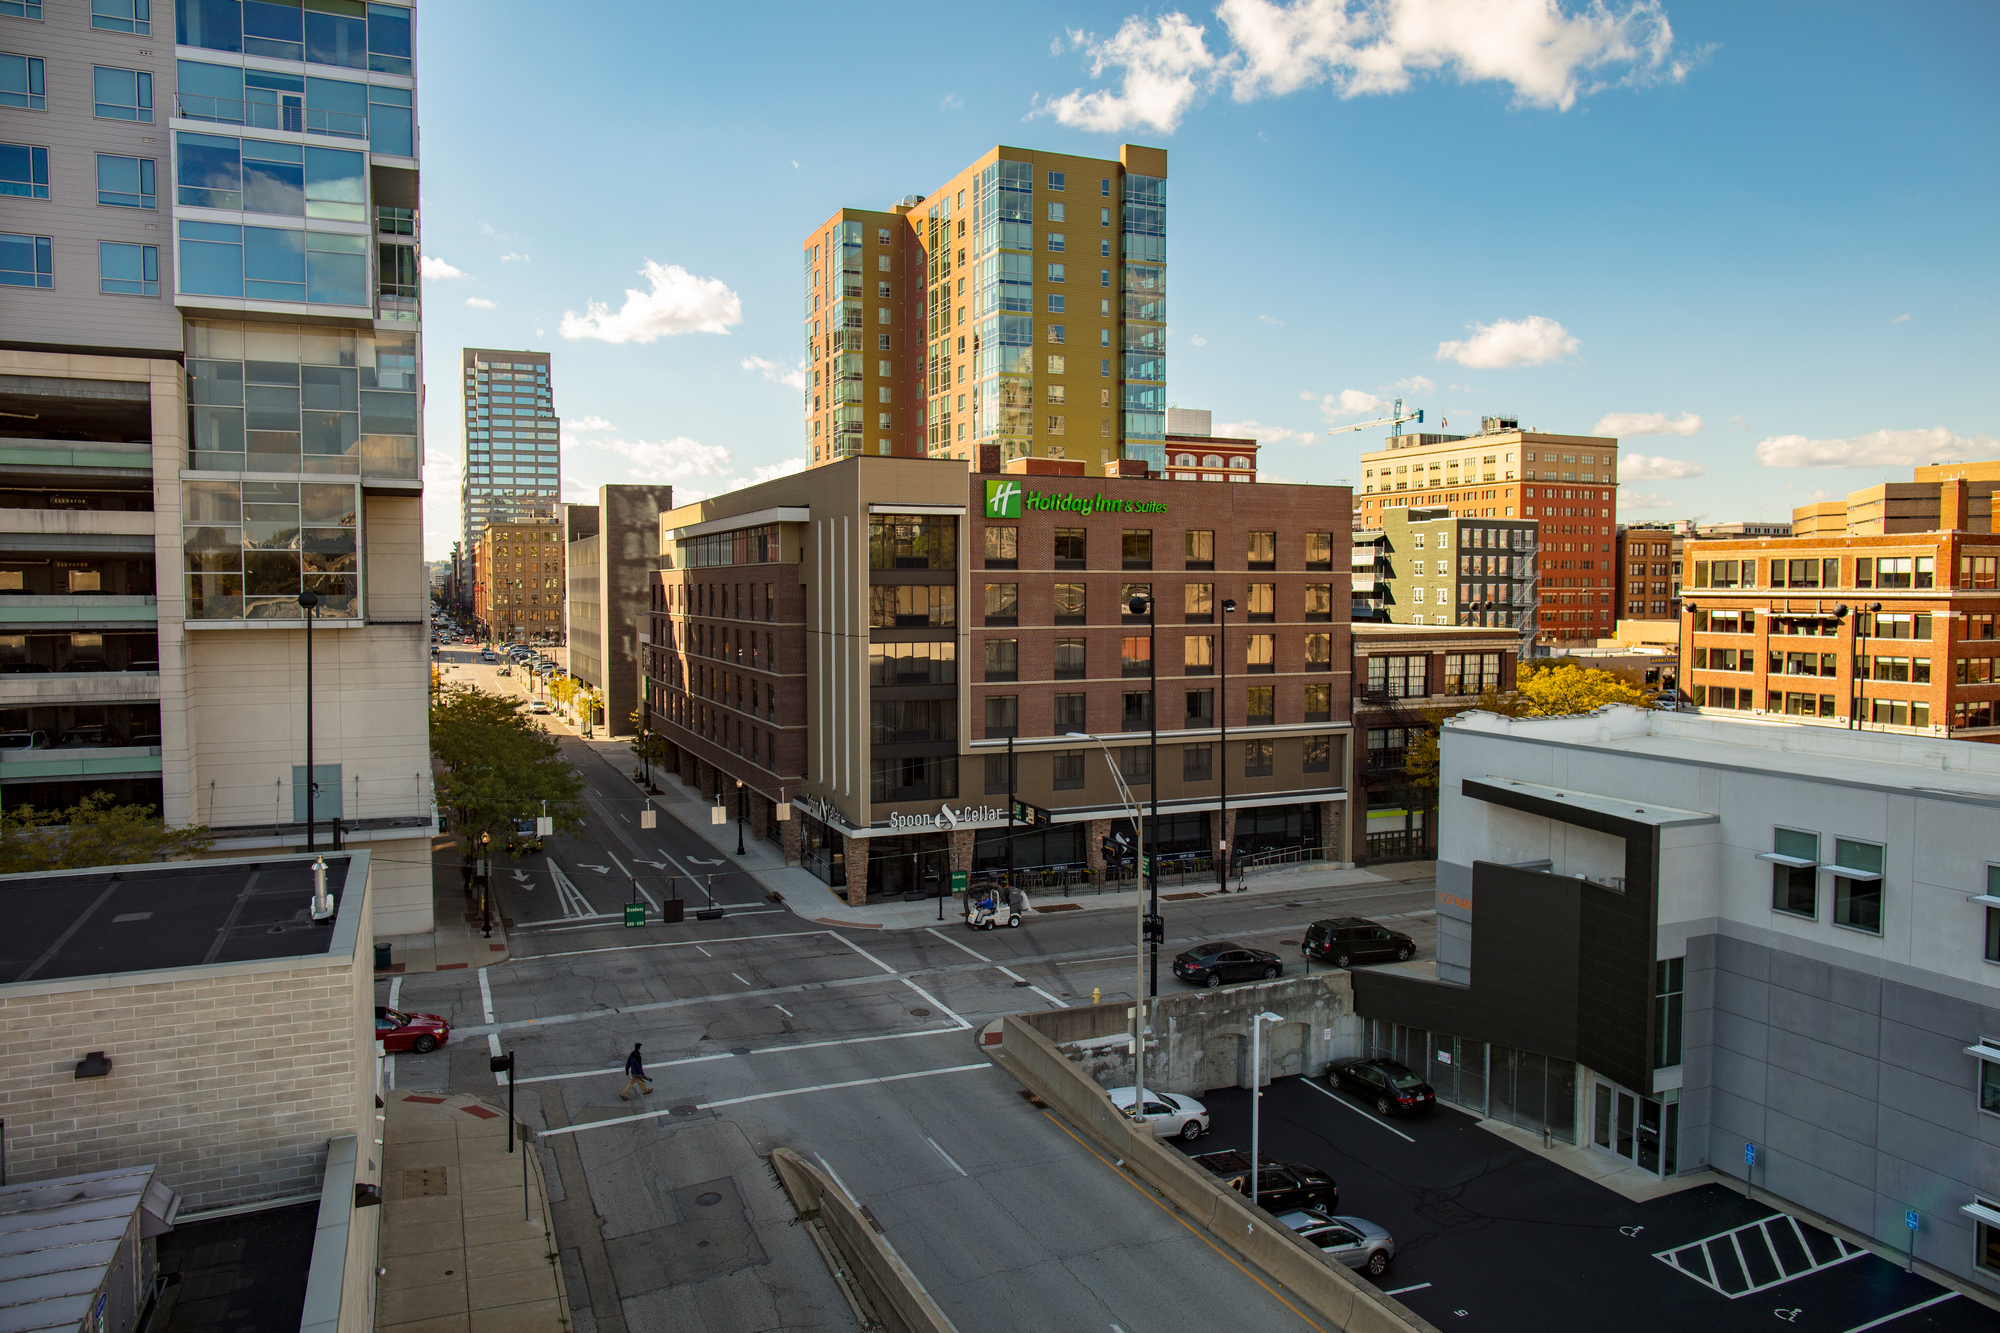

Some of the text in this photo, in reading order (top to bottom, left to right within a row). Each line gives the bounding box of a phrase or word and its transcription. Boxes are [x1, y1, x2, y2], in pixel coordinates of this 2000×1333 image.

[1025, 490, 1168, 516] Holiday Inn & Suites
[889, 811, 930, 831] Spoon
[934, 803, 960, 830] &
[964, 805, 1003, 822] Cellar
